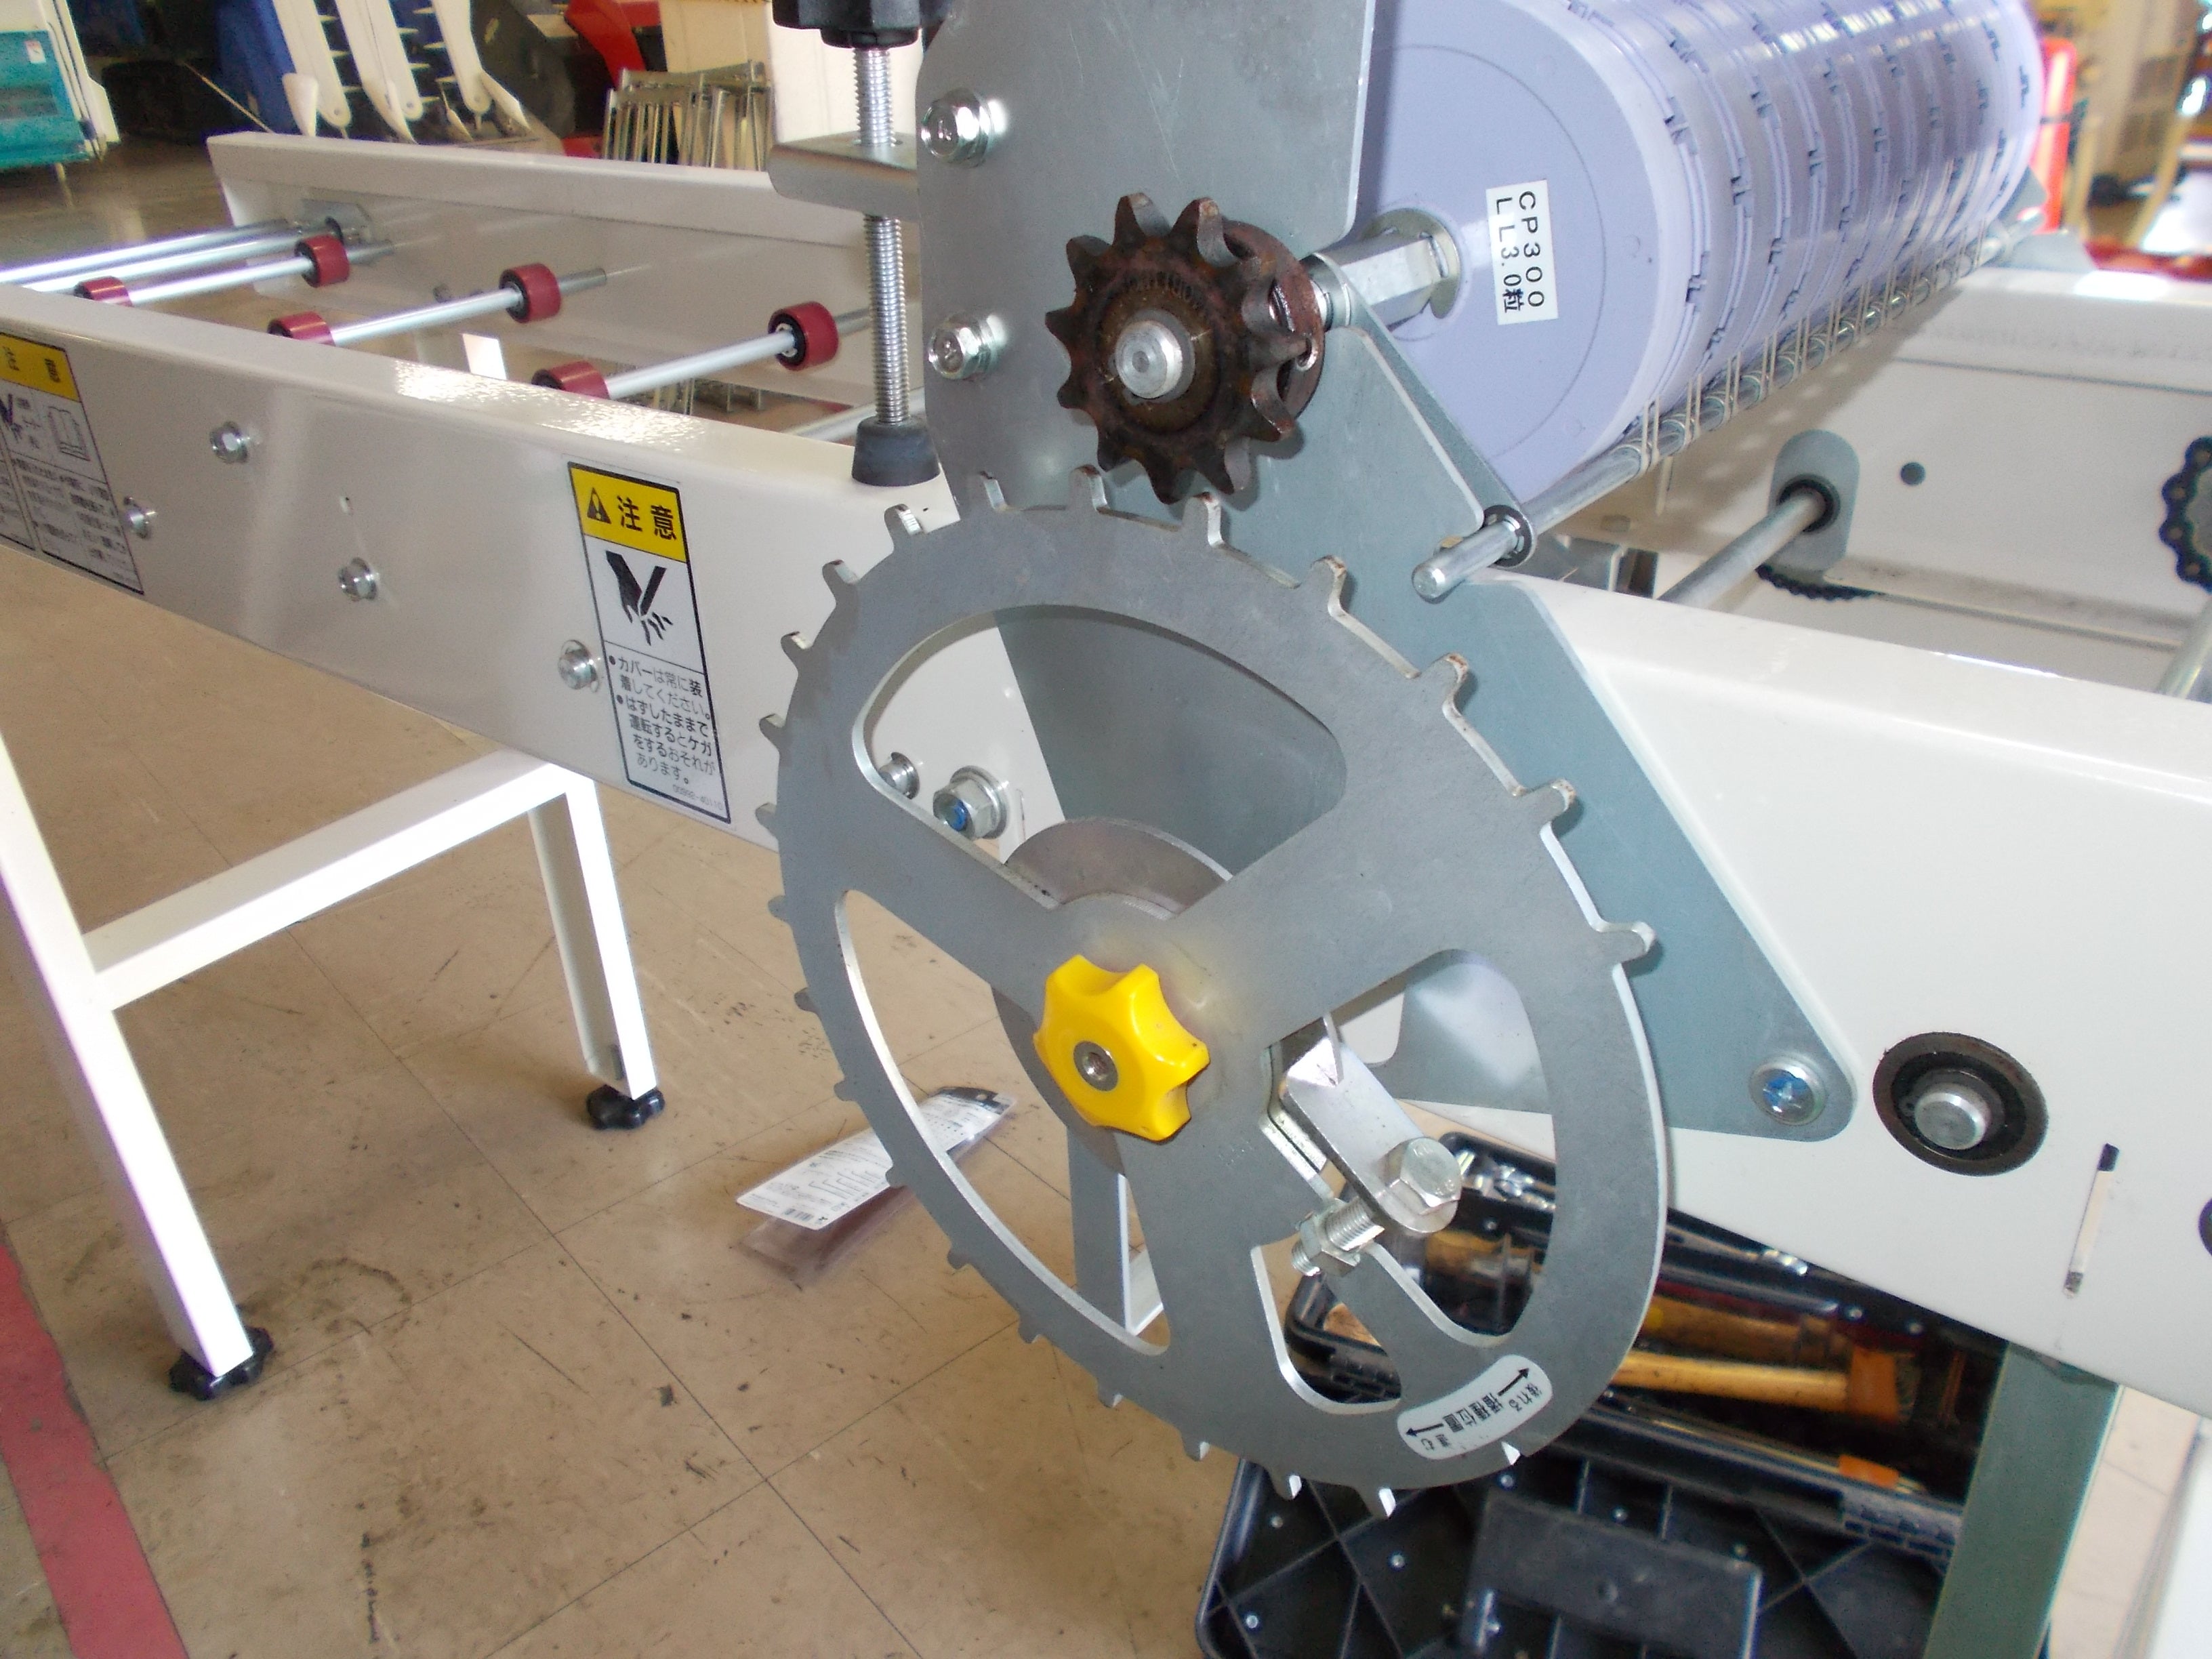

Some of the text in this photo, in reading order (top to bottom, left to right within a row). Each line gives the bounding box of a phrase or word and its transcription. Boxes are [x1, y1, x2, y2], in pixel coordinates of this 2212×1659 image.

[1519, 190, 1544, 307] CP300
[617, 495, 678, 541] 注意
[618, 657, 703, 698] カバーは常に装
[620, 674, 710, 720] 着してください。
[626, 695, 709, 737] はずしたままで
[629, 714, 712, 756] 運転するとケガ
[633, 734, 716, 775] をするおそれが
[636, 753, 689, 784] あります。
[1442, 1392, 1504, 1433] 播種位置
